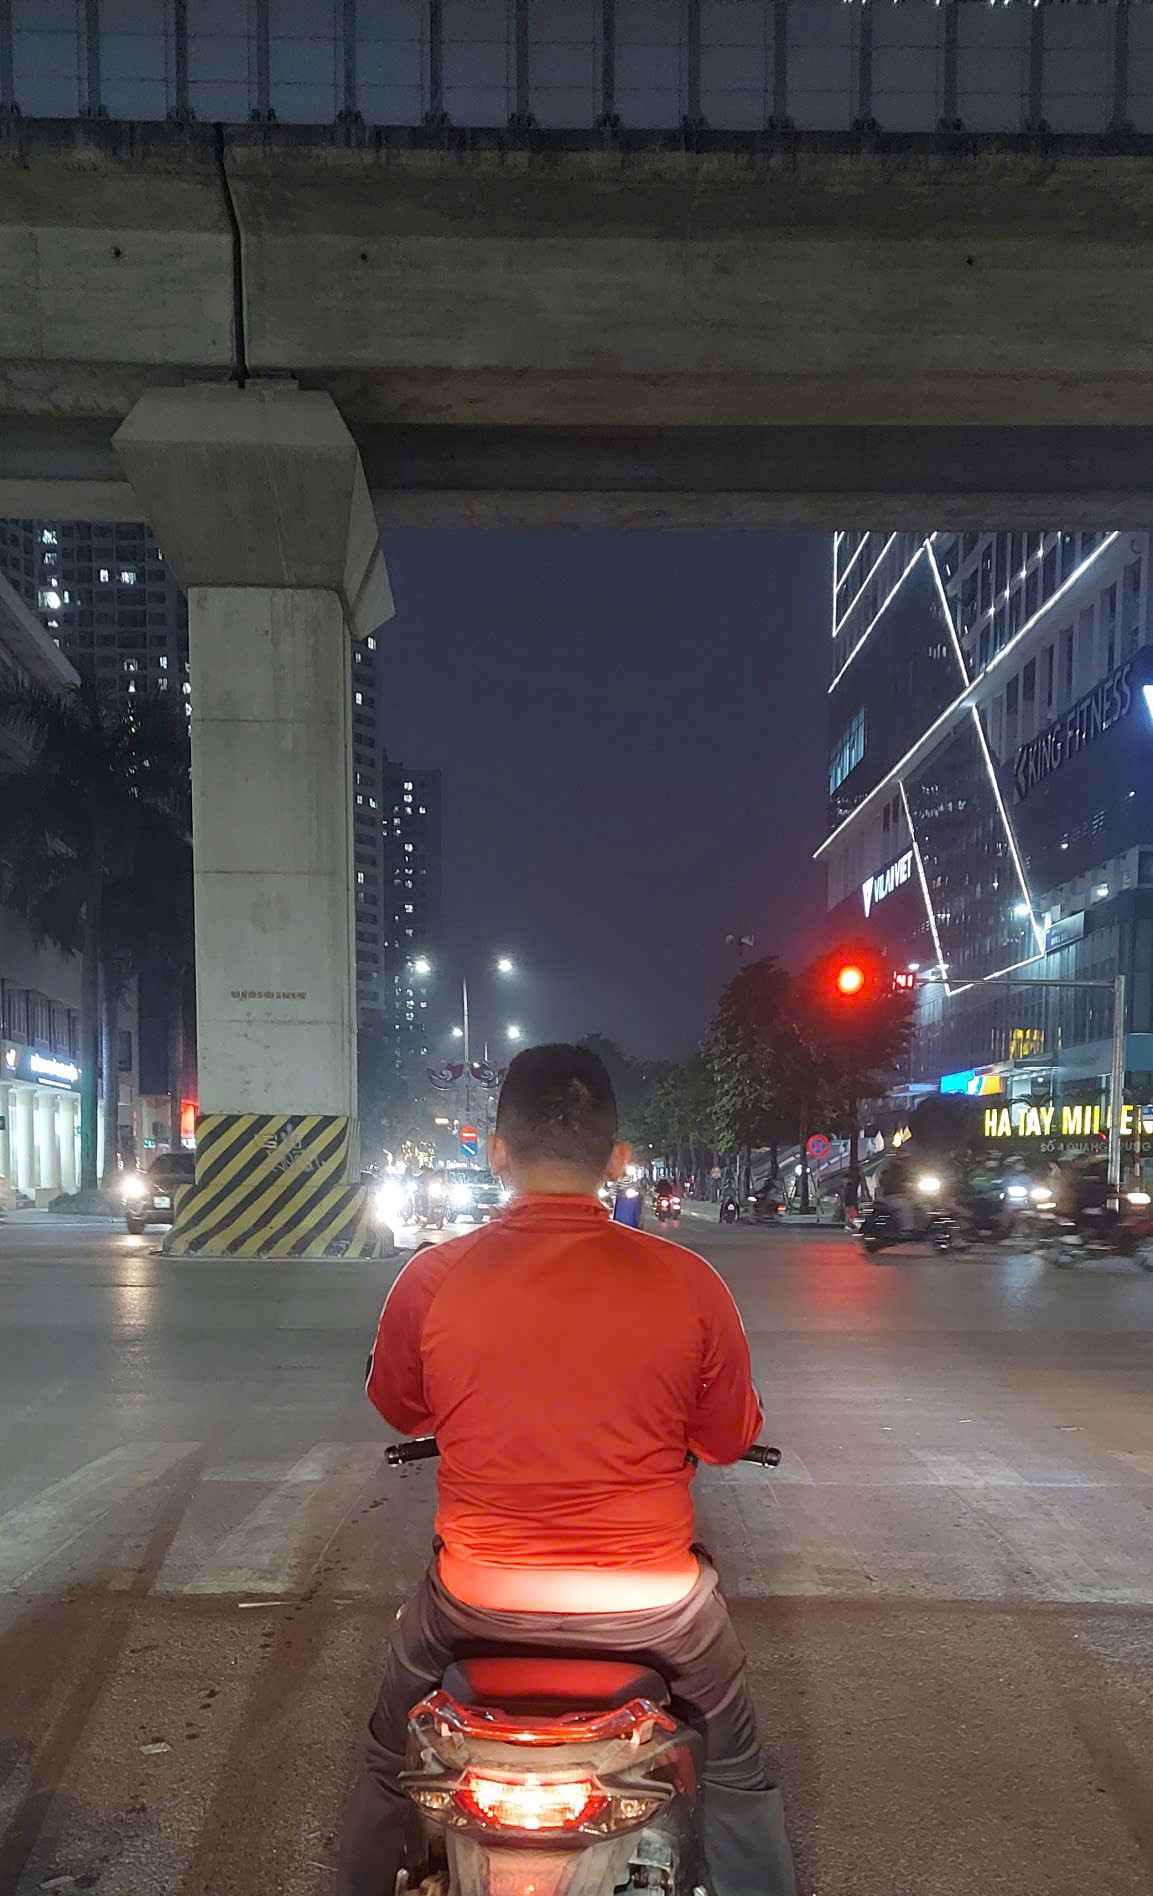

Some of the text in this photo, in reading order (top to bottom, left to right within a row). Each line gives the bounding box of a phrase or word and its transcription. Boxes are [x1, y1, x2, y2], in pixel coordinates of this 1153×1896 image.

[1028, 663, 1131, 788] KING FITNESS
[984, 1108, 1012, 1137] HA
[1018, 1106, 1055, 1136] TAY
